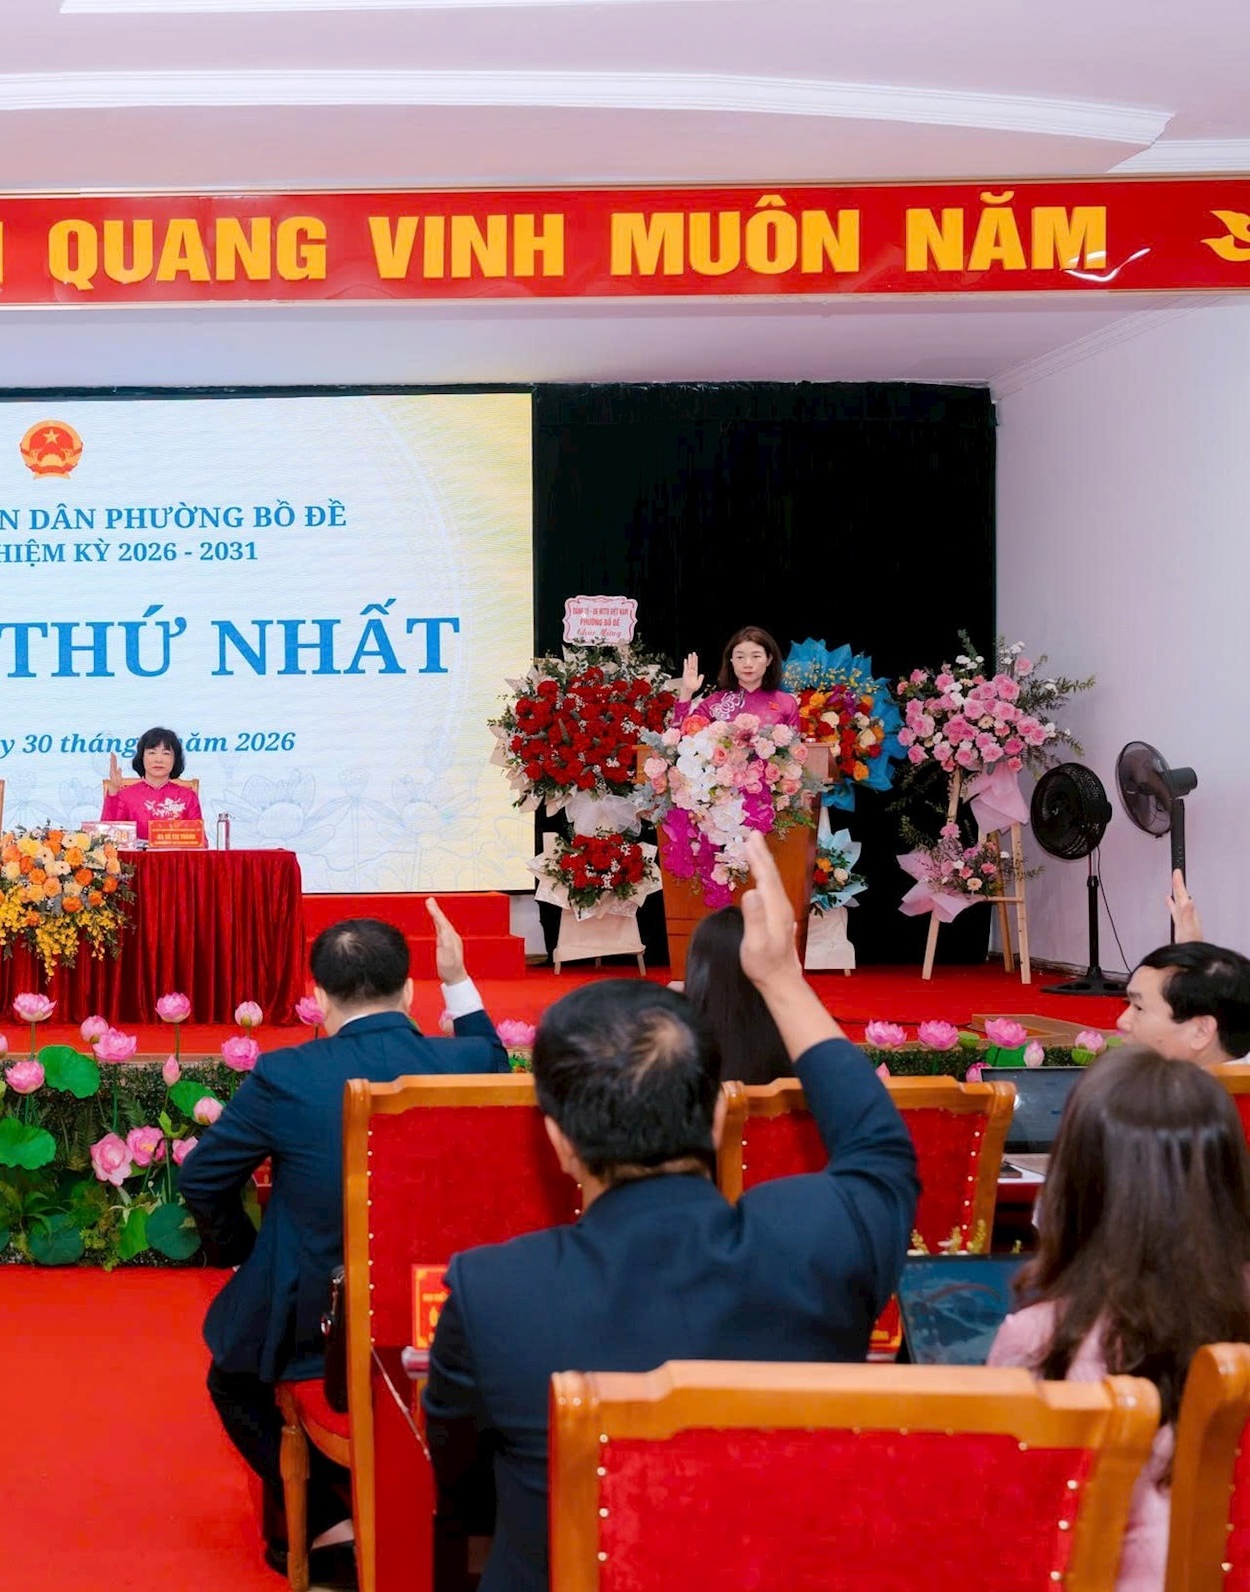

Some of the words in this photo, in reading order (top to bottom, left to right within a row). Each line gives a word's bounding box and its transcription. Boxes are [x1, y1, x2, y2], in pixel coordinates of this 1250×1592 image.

[48, 216, 327, 291] QUANG
[368, 213, 564, 279] VINH
[610, 194, 860, 276] MUÔN
[906, 191, 1107, 272] NĂM
[29, 502, 96, 531] DÂN
[105, 501, 245, 530] PHƯỜNG
[254, 499, 297, 528] BỒ
[305, 498, 348, 527] ĐỀ
[72, 536, 111, 565] KỲ
[118, 541, 179, 563] 2026
[199, 540, 258, 562] 2031
[210, 596, 462, 677] NHẤT
[23, 733, 54, 755] 30
[59, 732, 139, 759] tháng
[179, 732, 229, 753] ăm
[233, 731, 297, 753] 2026
